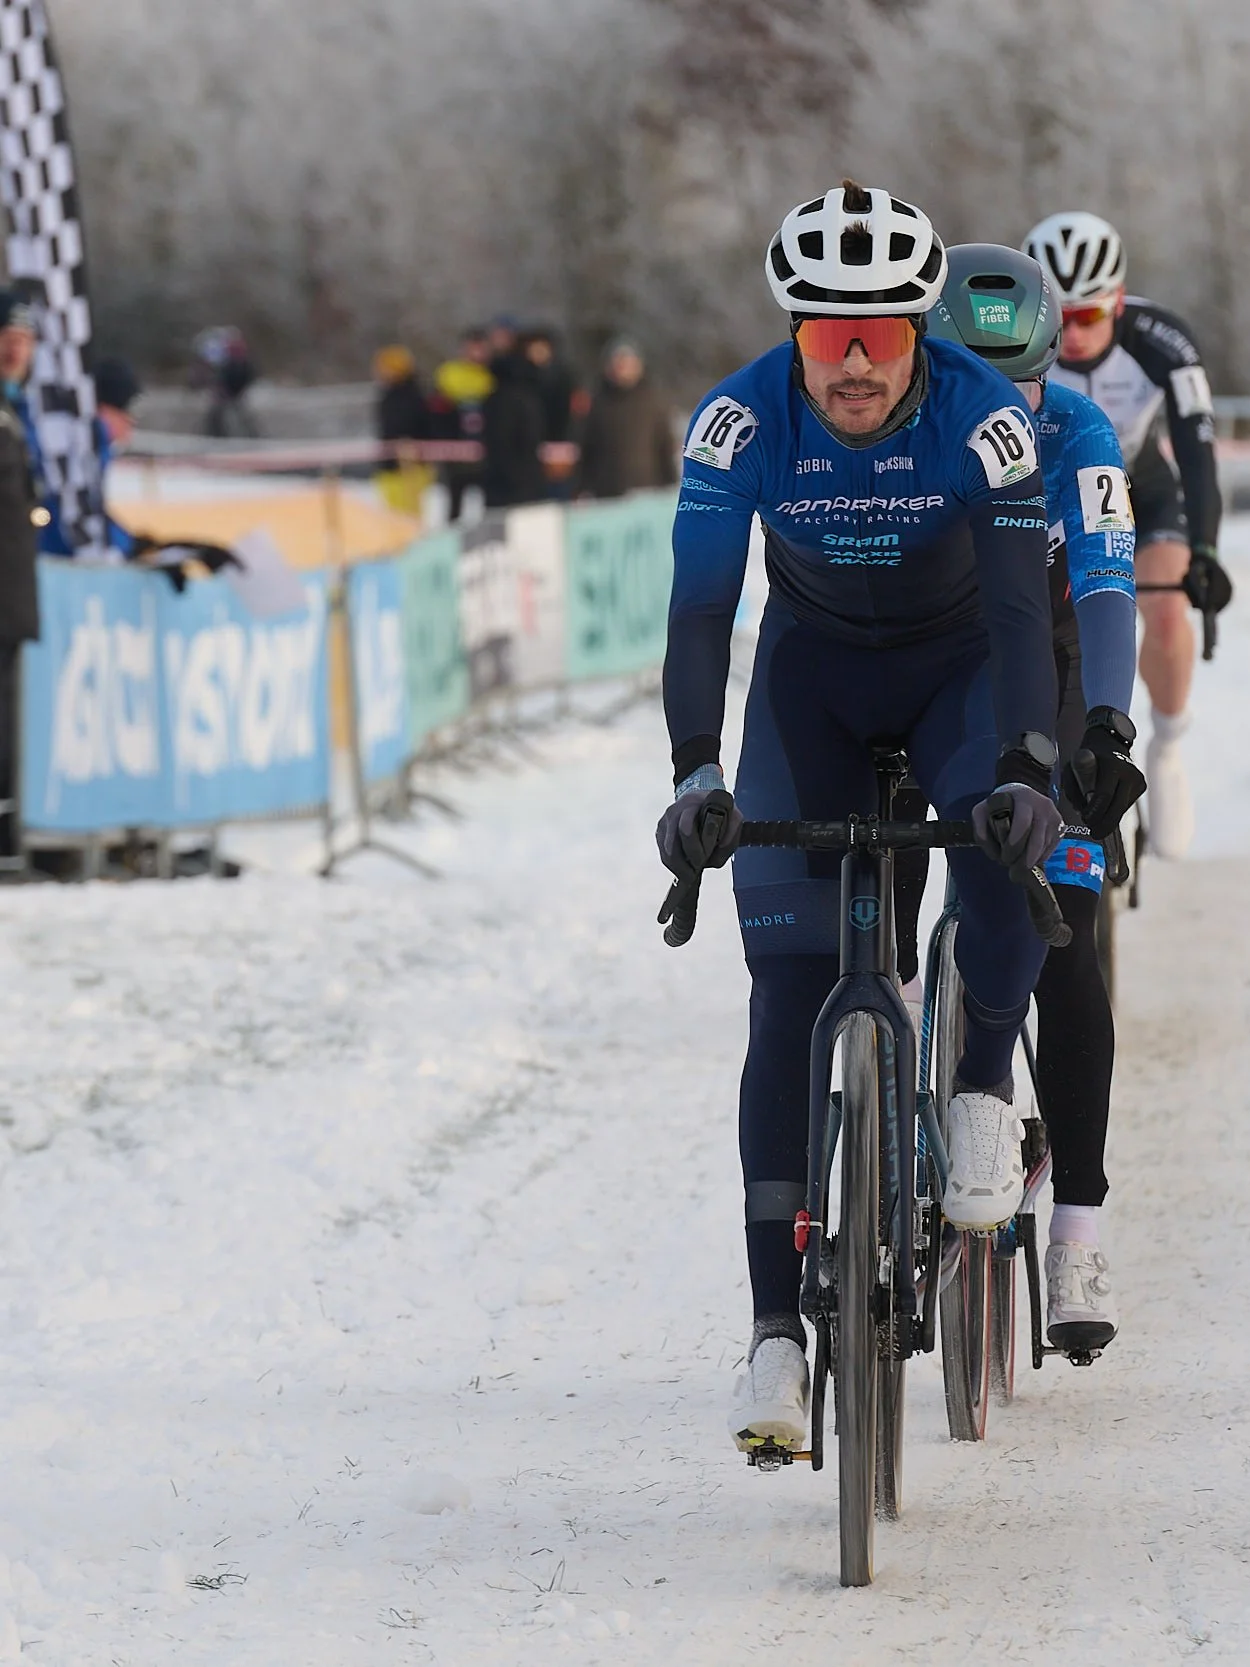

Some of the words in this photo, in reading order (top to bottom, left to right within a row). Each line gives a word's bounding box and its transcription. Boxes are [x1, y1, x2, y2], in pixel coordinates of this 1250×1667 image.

[978, 305, 1010, 316] BORN
[980, 313, 1011, 325] FIBER
[700, 405, 744, 448] 16
[979, 419, 1025, 468] 16
[796, 458, 833, 475] GOBIK
[874, 456, 914, 474] ROCKSHOX
[1096, 474, 1117, 515] 2
[794, 513, 859, 526] FACTORY
[866, 513, 921, 525] RACING
[821, 533, 900, 548] SRAM
[823, 550, 902, 560] MAXXIS
